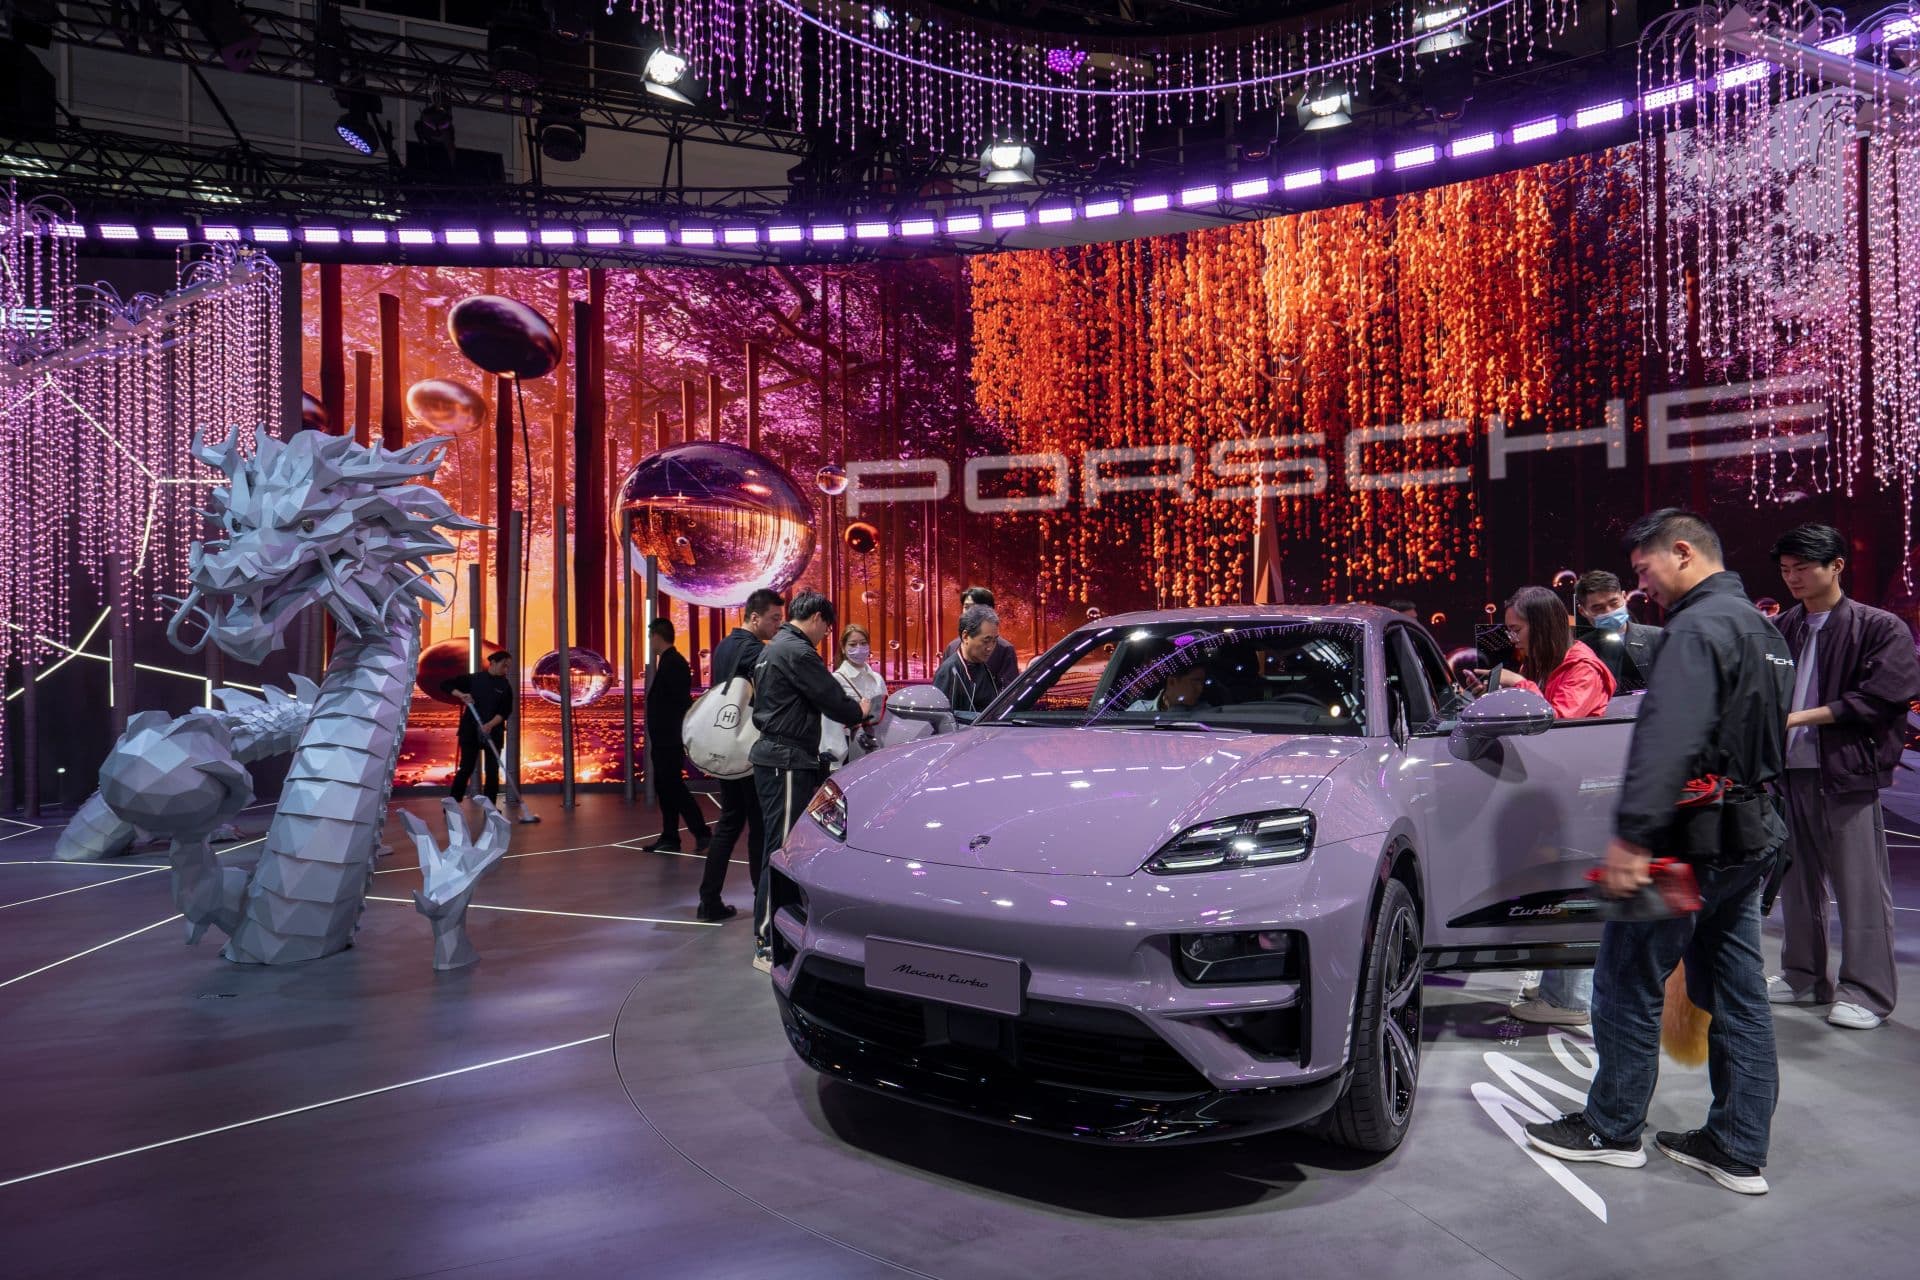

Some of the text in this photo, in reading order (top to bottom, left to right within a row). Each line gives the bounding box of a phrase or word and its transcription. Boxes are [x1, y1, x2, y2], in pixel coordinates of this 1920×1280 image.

[845, 371, 1828, 516] PORSCHE
[723, 711, 736, 723] Hi
[892, 963, 945, 981] Macan
